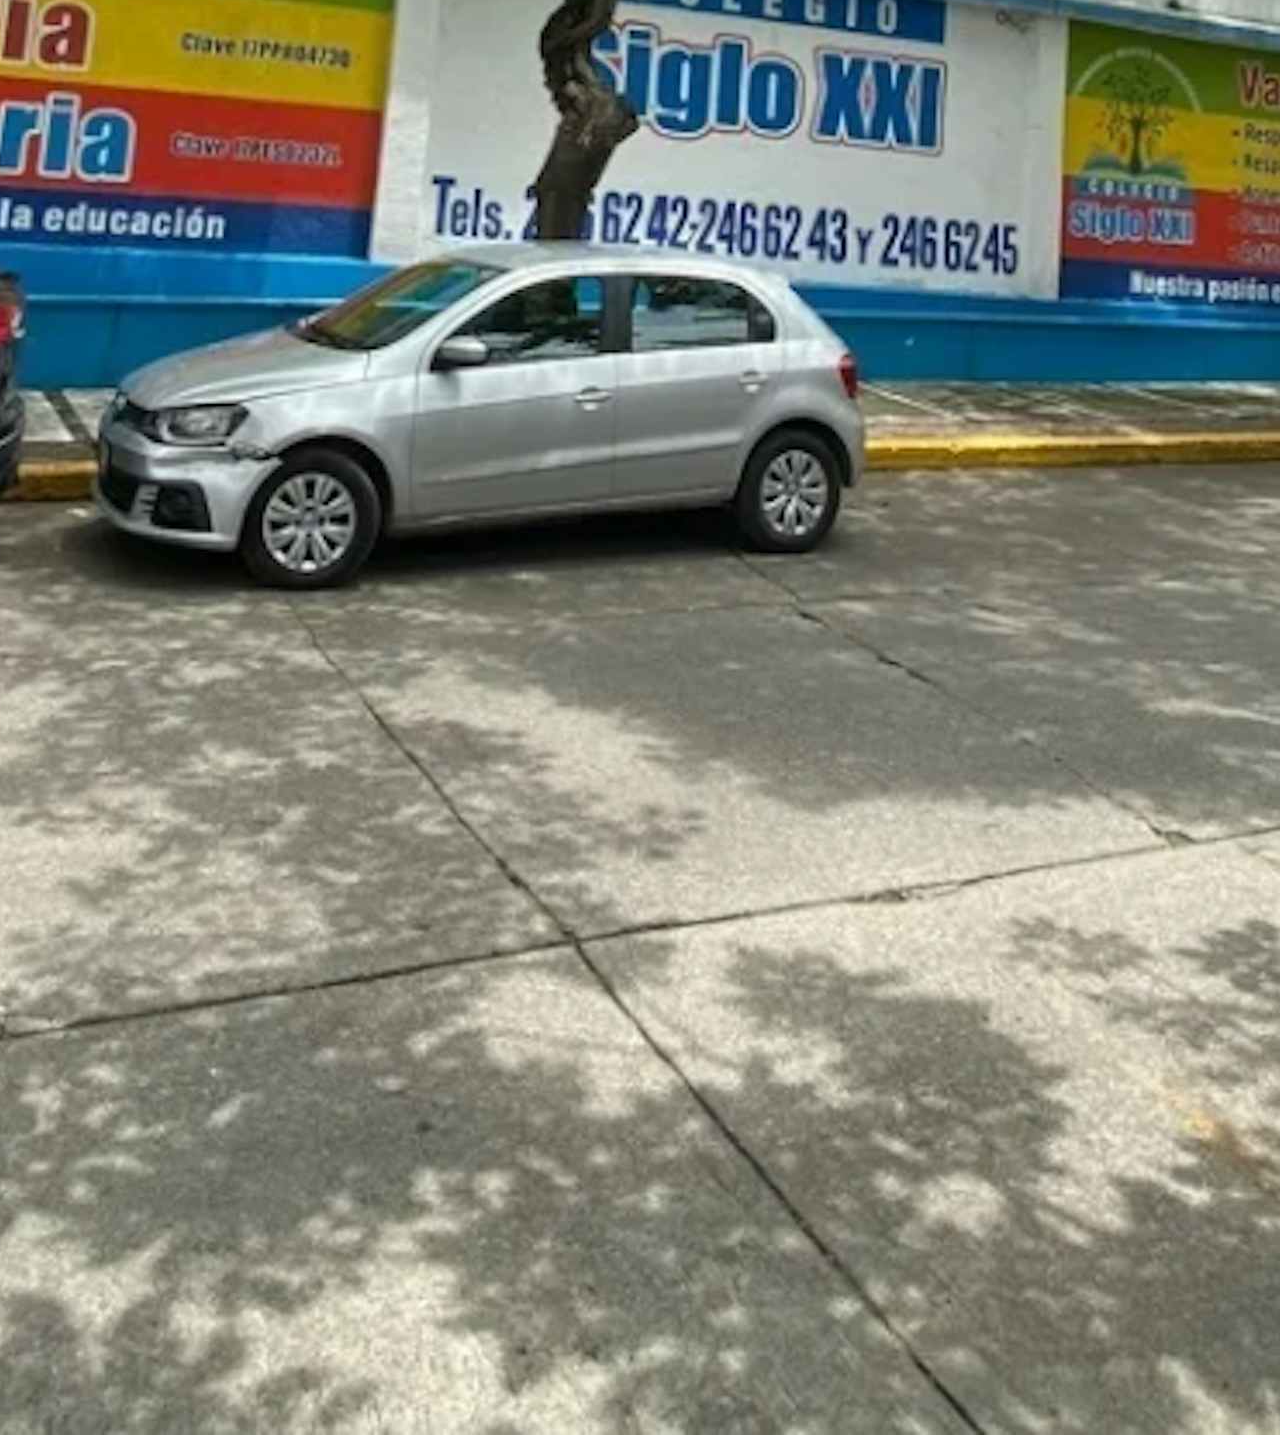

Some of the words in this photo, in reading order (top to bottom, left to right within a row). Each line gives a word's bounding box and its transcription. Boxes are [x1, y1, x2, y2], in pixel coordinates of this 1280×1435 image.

[180, 32, 236, 55] Clave
[811, 47, 947, 156] XXI
[172, 132, 227, 159] Clave
[42, 201, 227, 240] educación
[432, 175, 512, 240] Tels.
[1070, 201, 1145, 245] Siglo
[1147, 206, 1196, 246] XXI
[1129, 270, 1206, 298] Nuestra
[1207, 274, 1270, 305] pasión
